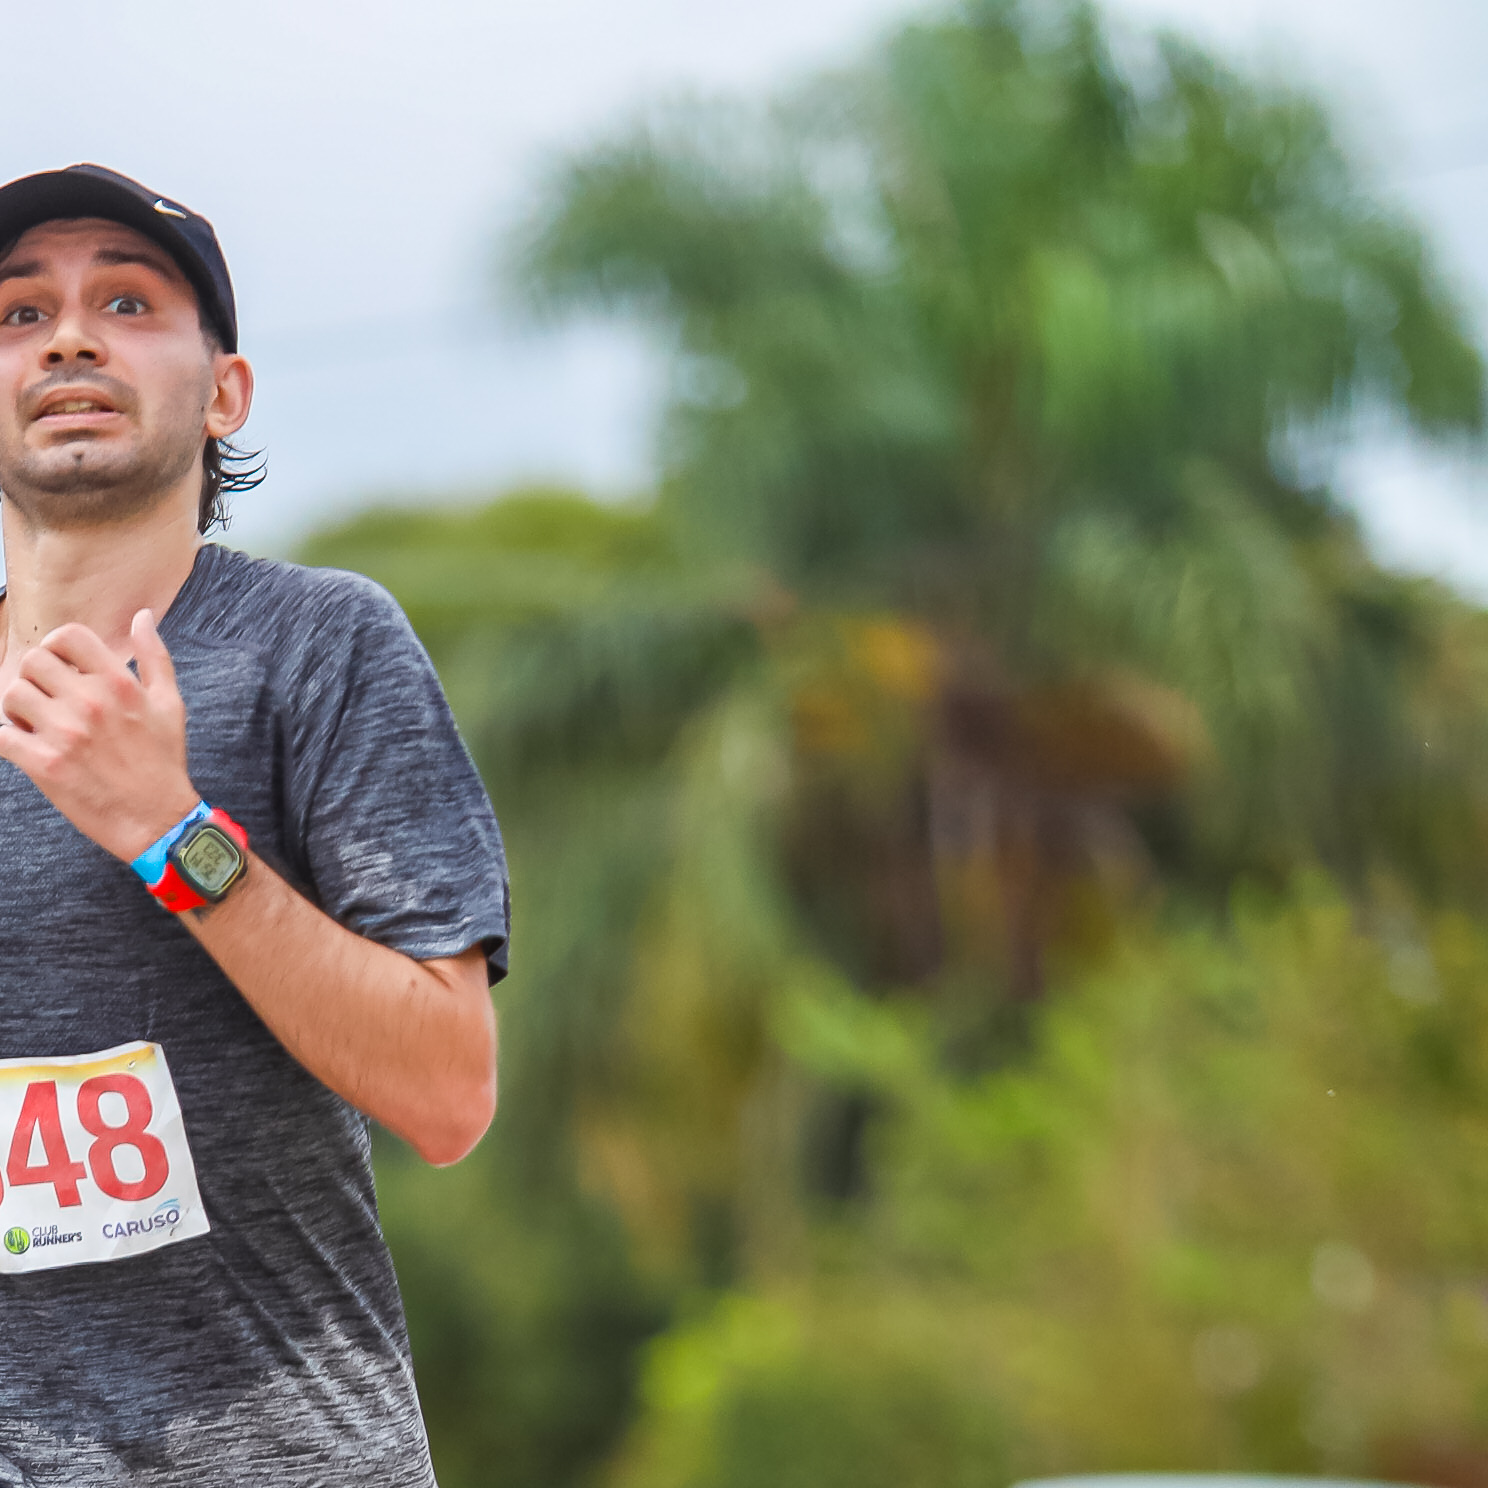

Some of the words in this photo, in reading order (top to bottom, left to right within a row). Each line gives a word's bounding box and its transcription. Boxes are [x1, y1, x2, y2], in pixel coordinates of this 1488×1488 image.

[31, 1224, 59, 1238] CLUB
[101, 1208, 180, 1240] CARUSO
[31, 1231, 83, 1248] RUNNER'S
